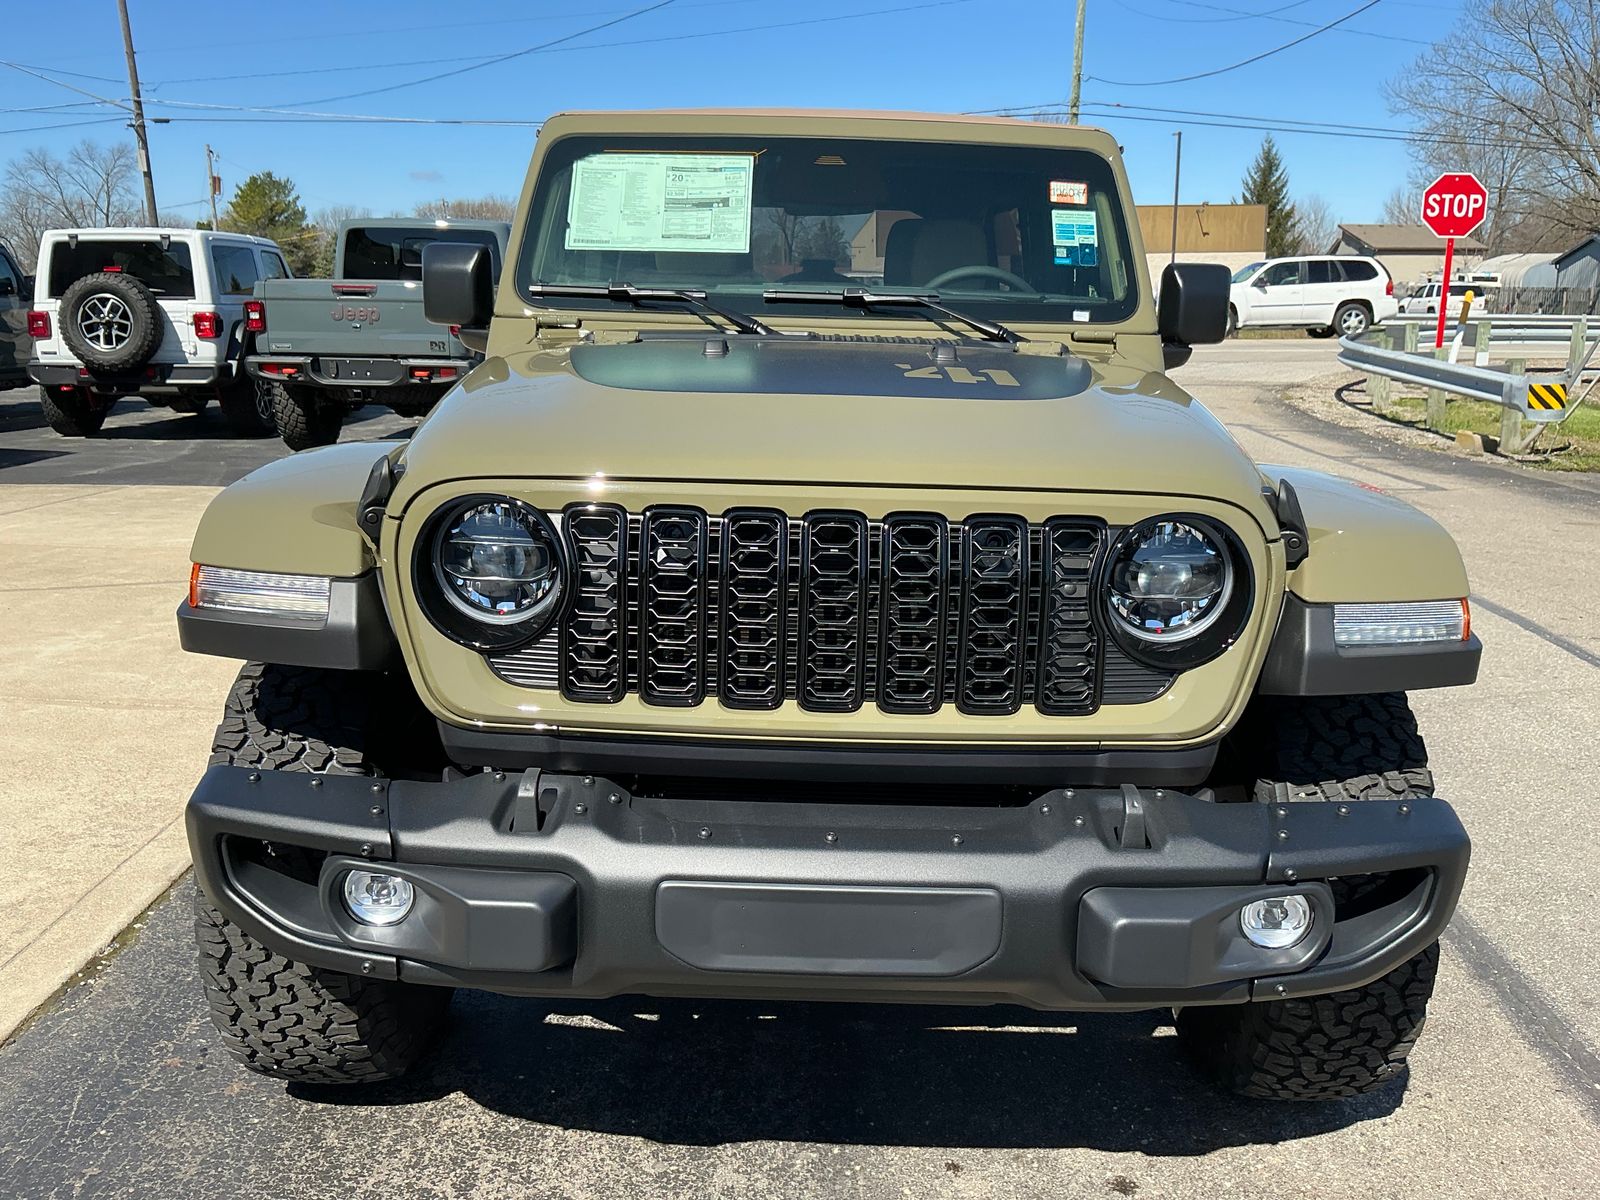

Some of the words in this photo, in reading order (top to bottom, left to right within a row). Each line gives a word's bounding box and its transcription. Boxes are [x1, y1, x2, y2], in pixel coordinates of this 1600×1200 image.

[671, 174, 684, 182] 20
[1426, 193, 1483, 218] STOP
[331, 303, 380, 325] Jeep
